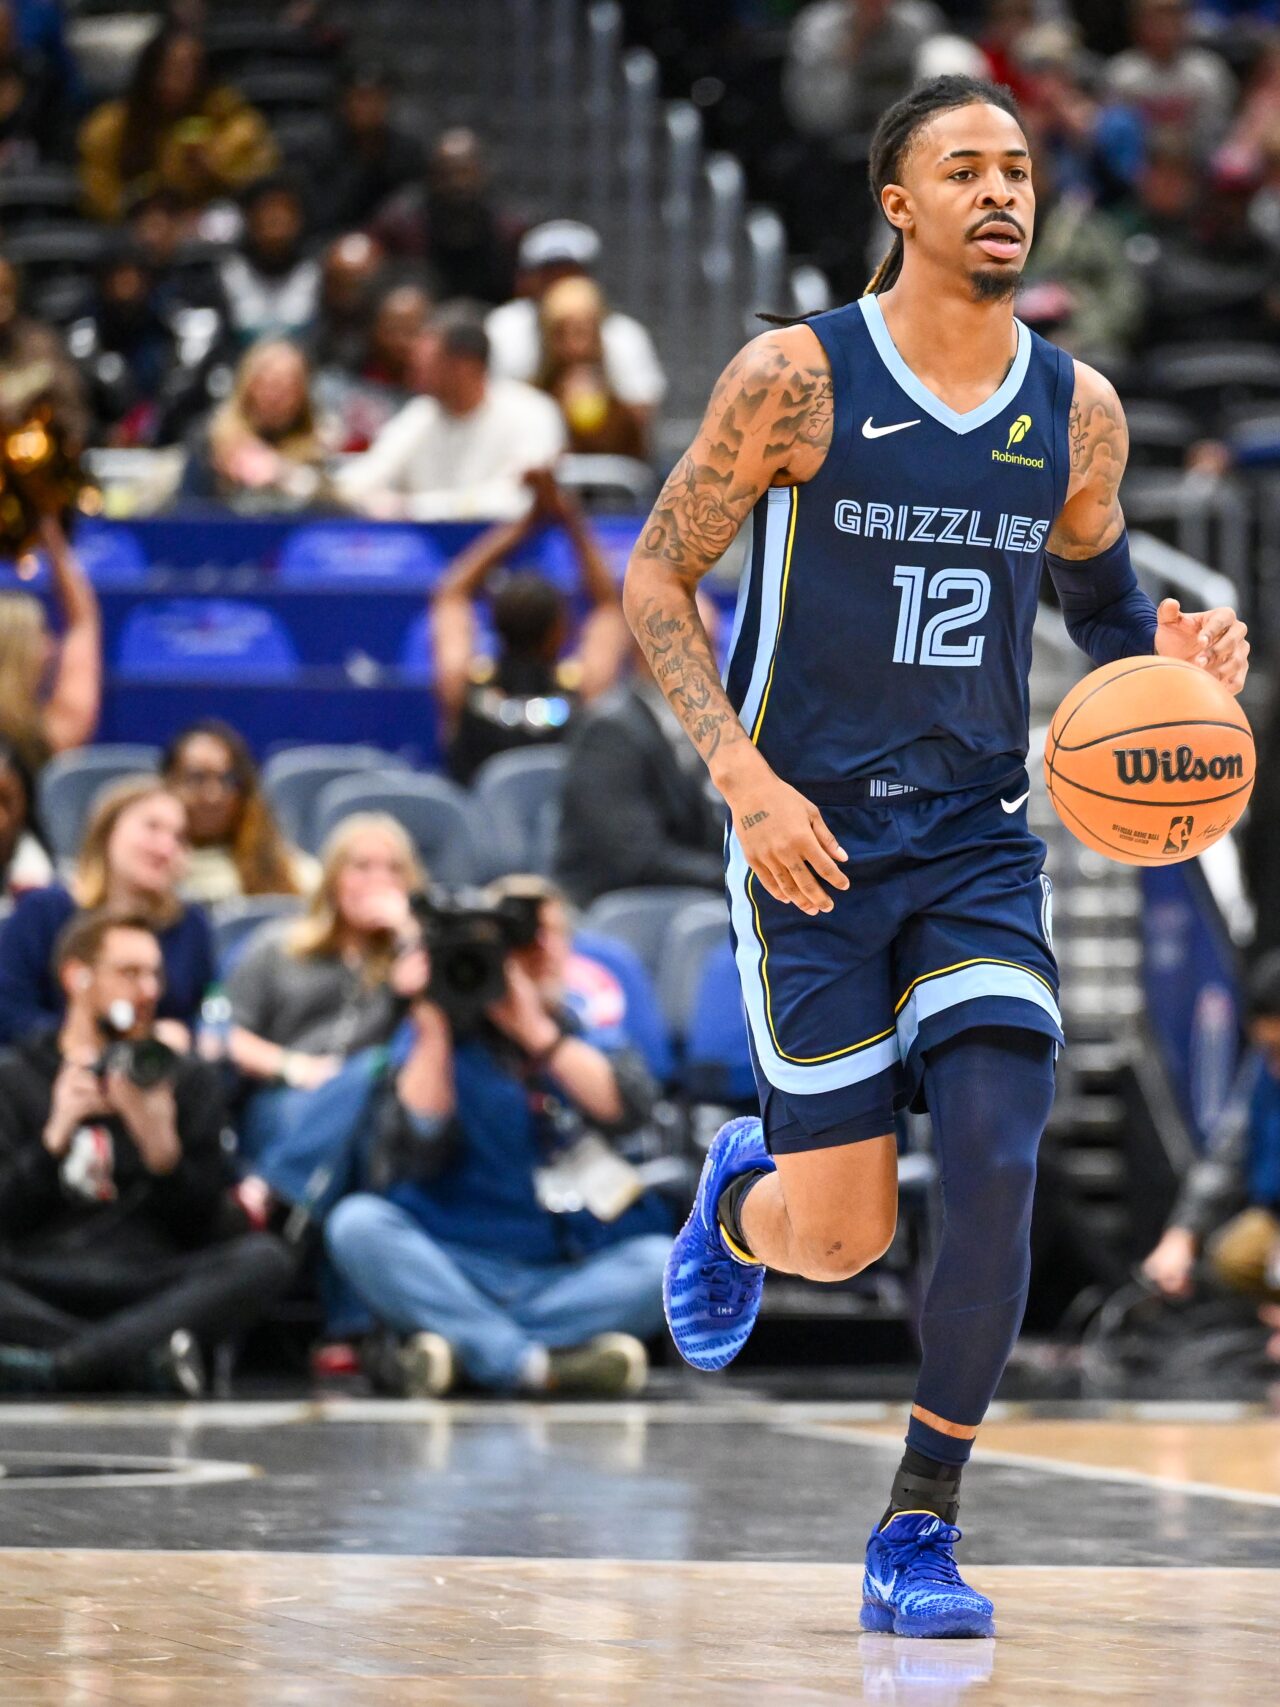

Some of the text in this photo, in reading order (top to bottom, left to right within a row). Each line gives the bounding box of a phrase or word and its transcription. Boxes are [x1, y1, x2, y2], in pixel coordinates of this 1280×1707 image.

[991, 449, 1044, 469] Robinhood
[834, 499, 1050, 553] GRIZZLIES
[892, 565, 991, 667] 12
[1112, 744, 1244, 785] Wilson
